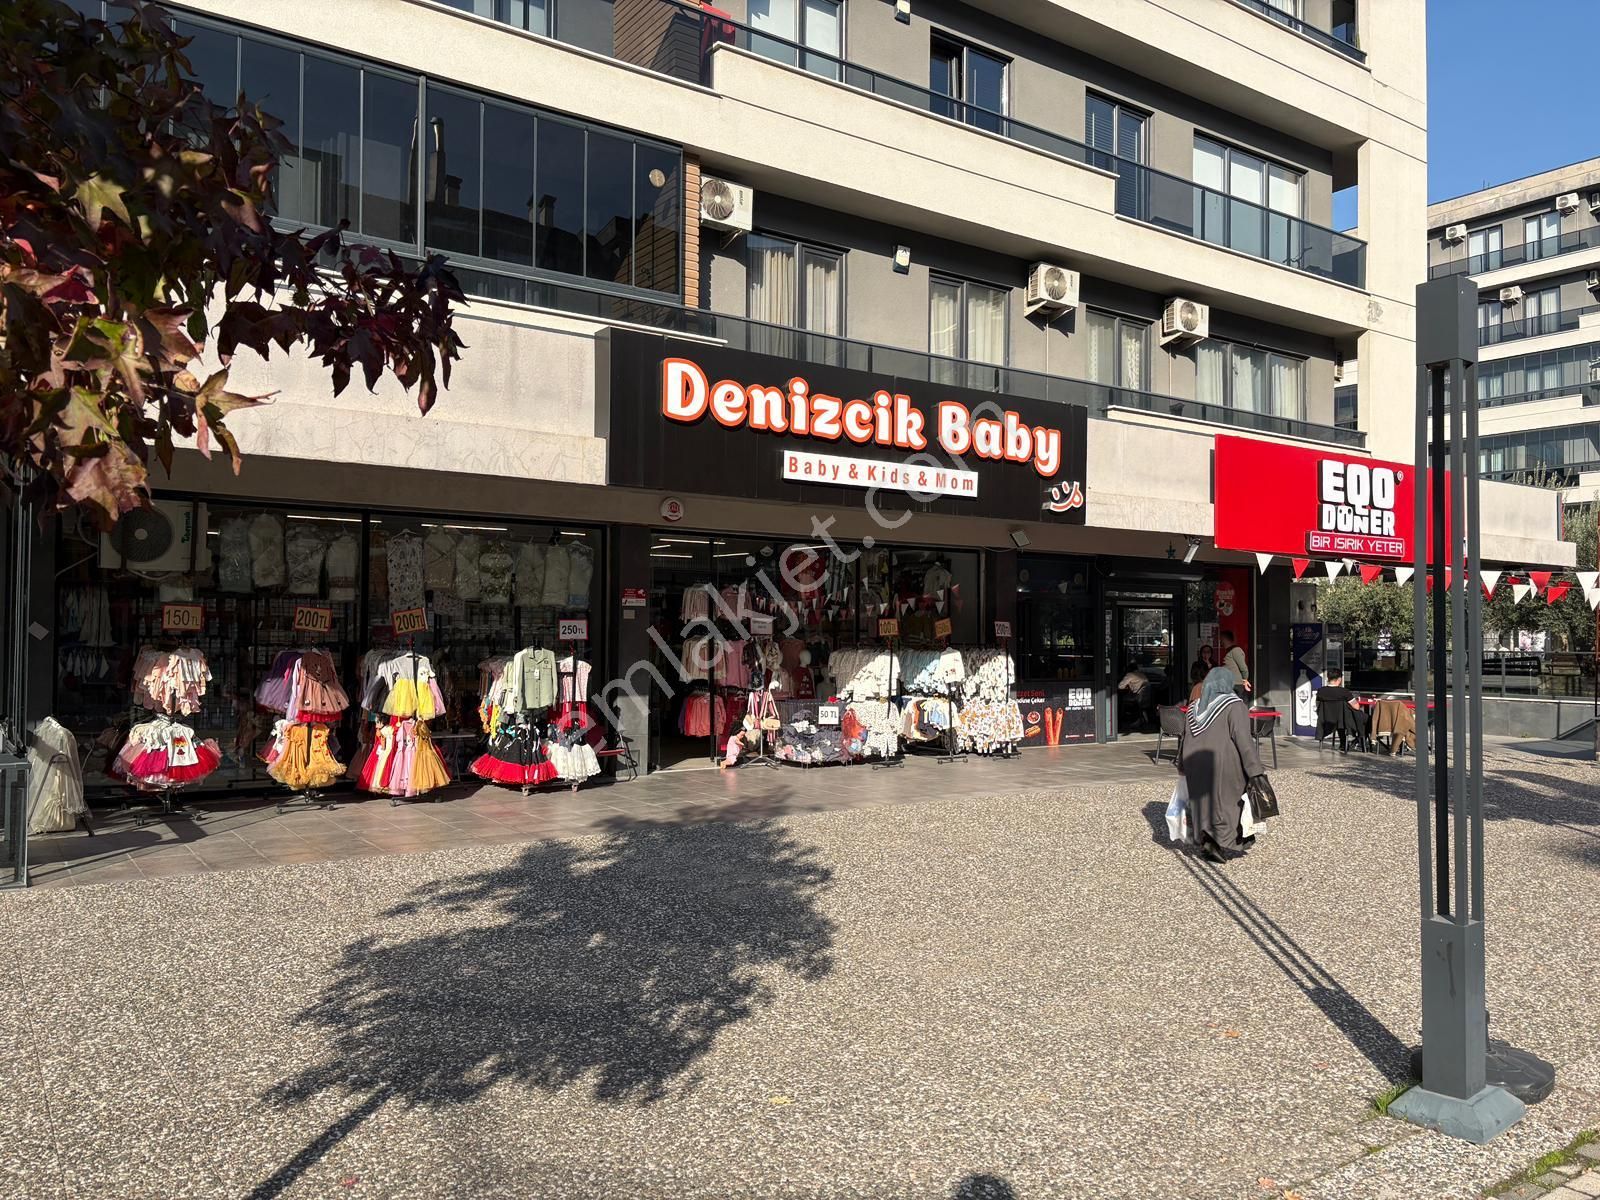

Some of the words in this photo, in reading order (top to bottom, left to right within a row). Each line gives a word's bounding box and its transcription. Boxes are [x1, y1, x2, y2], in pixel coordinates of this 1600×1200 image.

[662, 357, 927, 450] Denizcik
[937, 401, 1061, 477] Baby
[789, 456, 839, 480] Baby
[849, 463, 858, 479] &
[867, 465, 909, 484] Kids
[918, 471, 928, 487] &
[935, 472, 974, 491] Mom
[1322, 459, 1395, 513] EQO
[1334, 537, 1364, 551] ISIRIK
[1367, 540, 1403, 554] YETER
[820, 710, 829, 719] 50
[830, 710, 838, 719] TL
